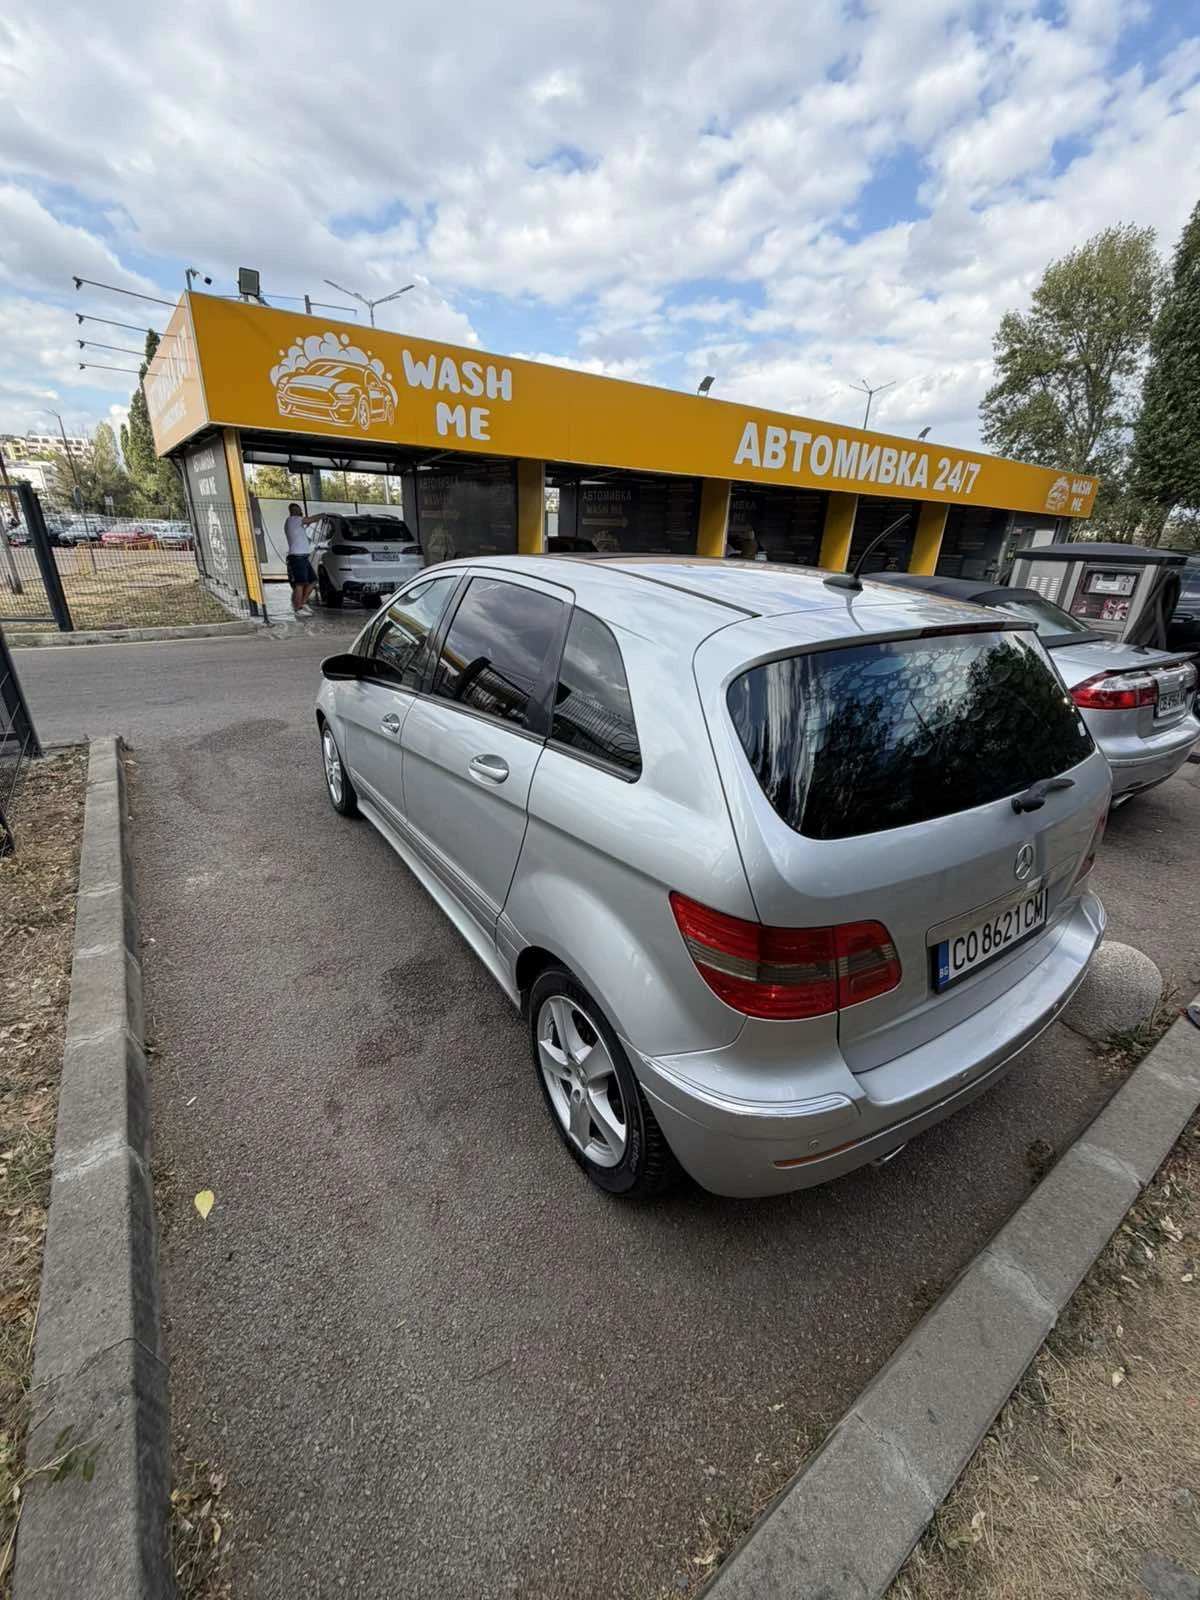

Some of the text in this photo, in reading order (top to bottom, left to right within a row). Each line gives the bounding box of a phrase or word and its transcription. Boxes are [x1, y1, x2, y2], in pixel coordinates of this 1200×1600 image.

[401, 349, 513, 401] WASH
[435, 402, 491, 441] ME
[733, 422, 982, 495] АВТОМИВКА 24/7
[953, 891, 1043, 970] CO 8621 CM
